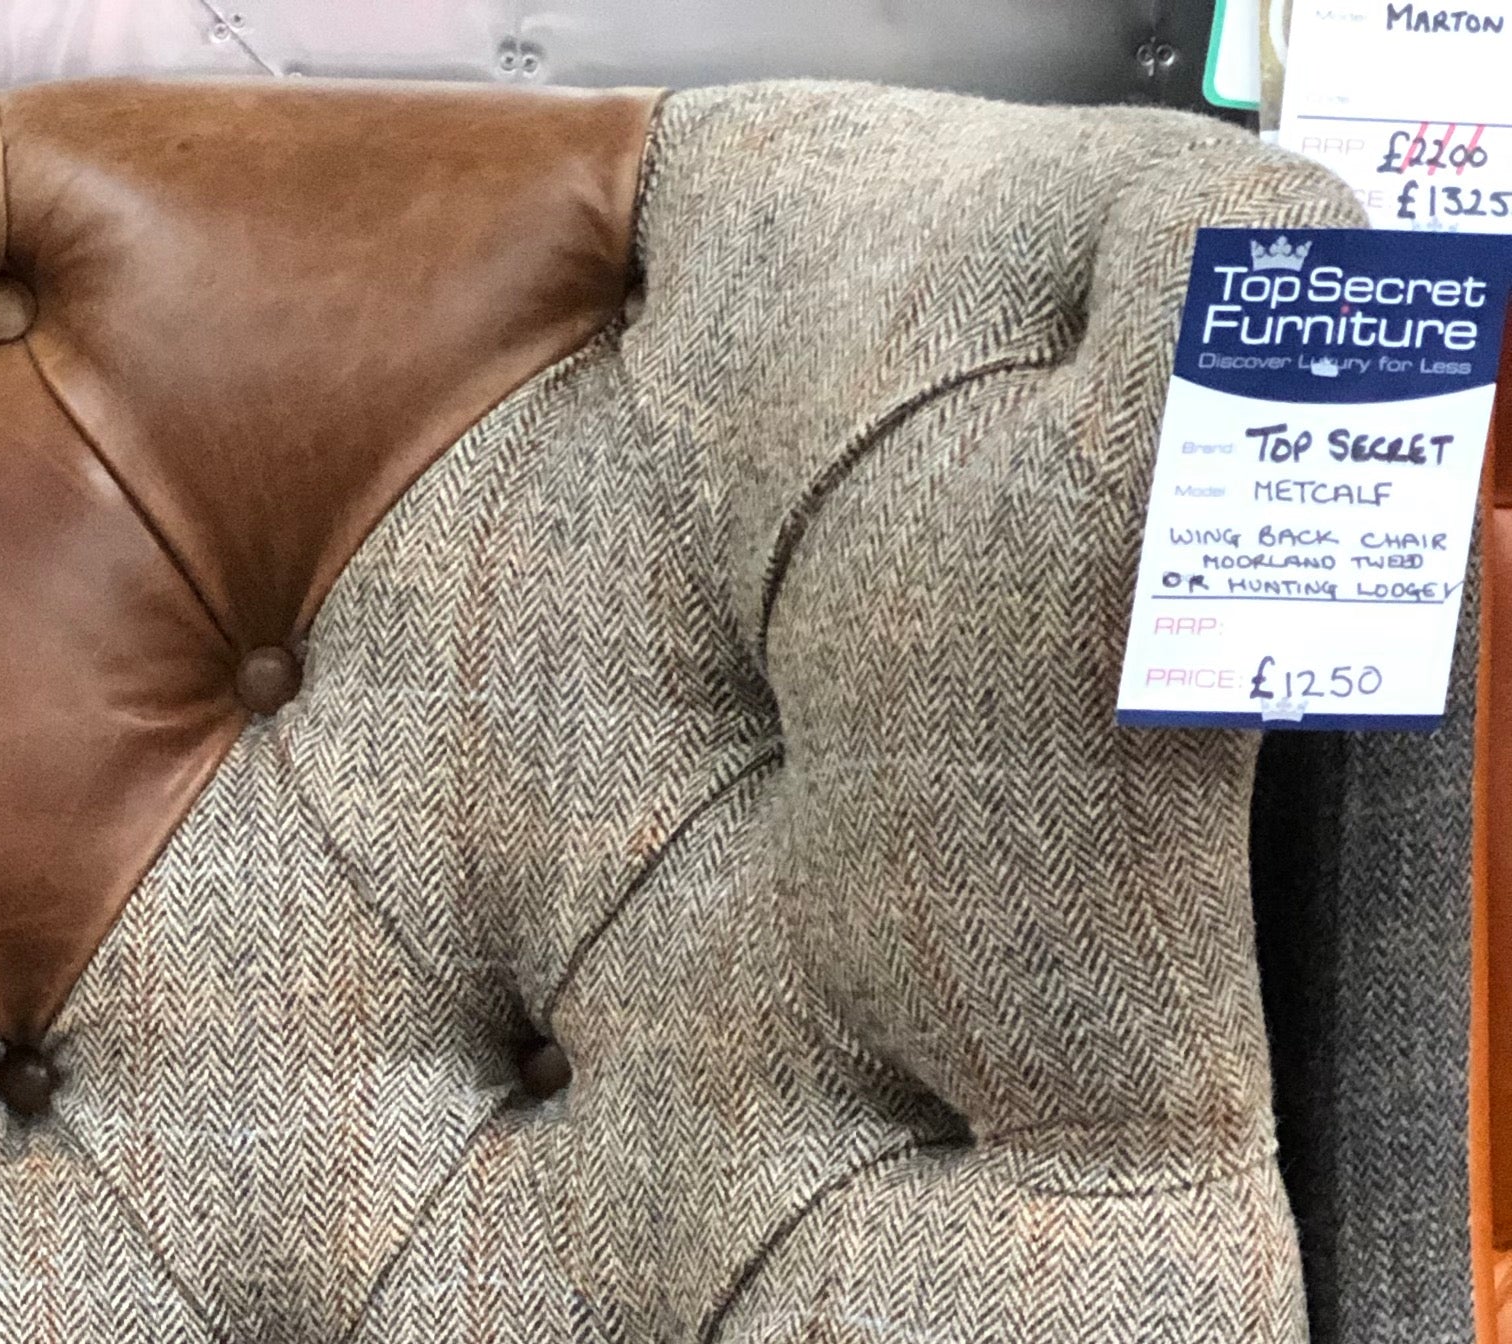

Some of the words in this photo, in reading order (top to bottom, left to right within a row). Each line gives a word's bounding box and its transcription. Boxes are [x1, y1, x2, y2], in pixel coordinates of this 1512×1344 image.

[1387, 3, 1504, 34] MARTON
[1376, 130, 1488, 174] £2200
[1396, 179, 1512, 220] £1325
[1214, 266, 1301, 309] Top
[1307, 266, 1487, 307] Secret
[1202, 303, 1478, 351] Furniture
[1198, 352, 1292, 369] Discover
[1378, 355, 1413, 371] for
[1419, 357, 1473, 375] Less
[1245, 423, 1313, 463] TOP
[1328, 427, 1455, 465] SECRET
[1254, 479, 1393, 506] METCALF
[1170, 527, 1241, 549] WING
[1258, 525, 1340, 548] BACK
[1360, 532, 1448, 551] CHAIR
[1203, 553, 1336, 569] MOORLAND
[1162, 570, 1210, 593] OR
[1228, 577, 1338, 600] HUNTING
[1250, 655, 1383, 700] £1250
